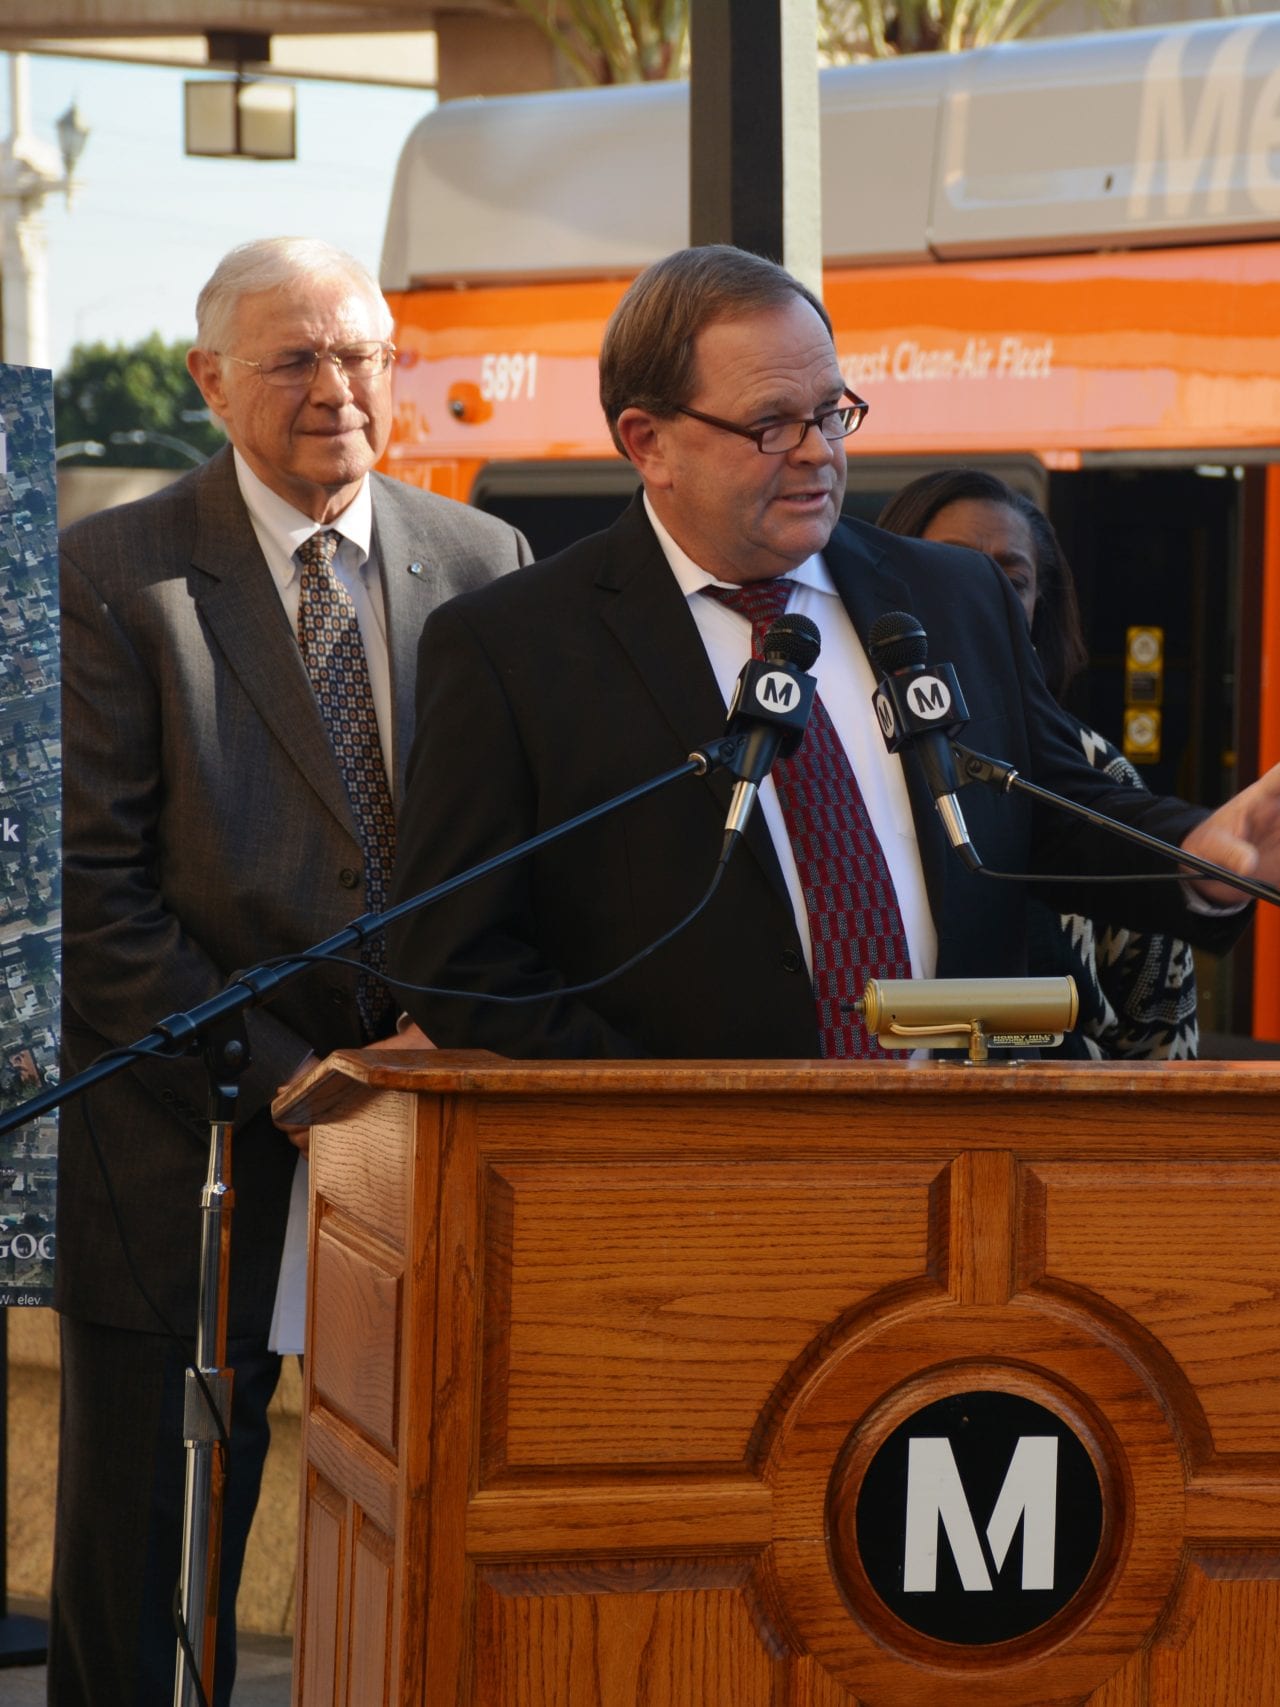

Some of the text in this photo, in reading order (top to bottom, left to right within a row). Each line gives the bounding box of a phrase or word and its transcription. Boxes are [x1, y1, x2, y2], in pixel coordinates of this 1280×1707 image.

[998, 337, 1053, 379] Fleet
[482, 353, 538, 401] 5891
[763, 677, 793, 707] M
[913, 683, 945, 713] M
[877, 700, 893, 733] M
[17, 1294, 41, 1305] elev
[904, 1436, 1058, 1592] M
